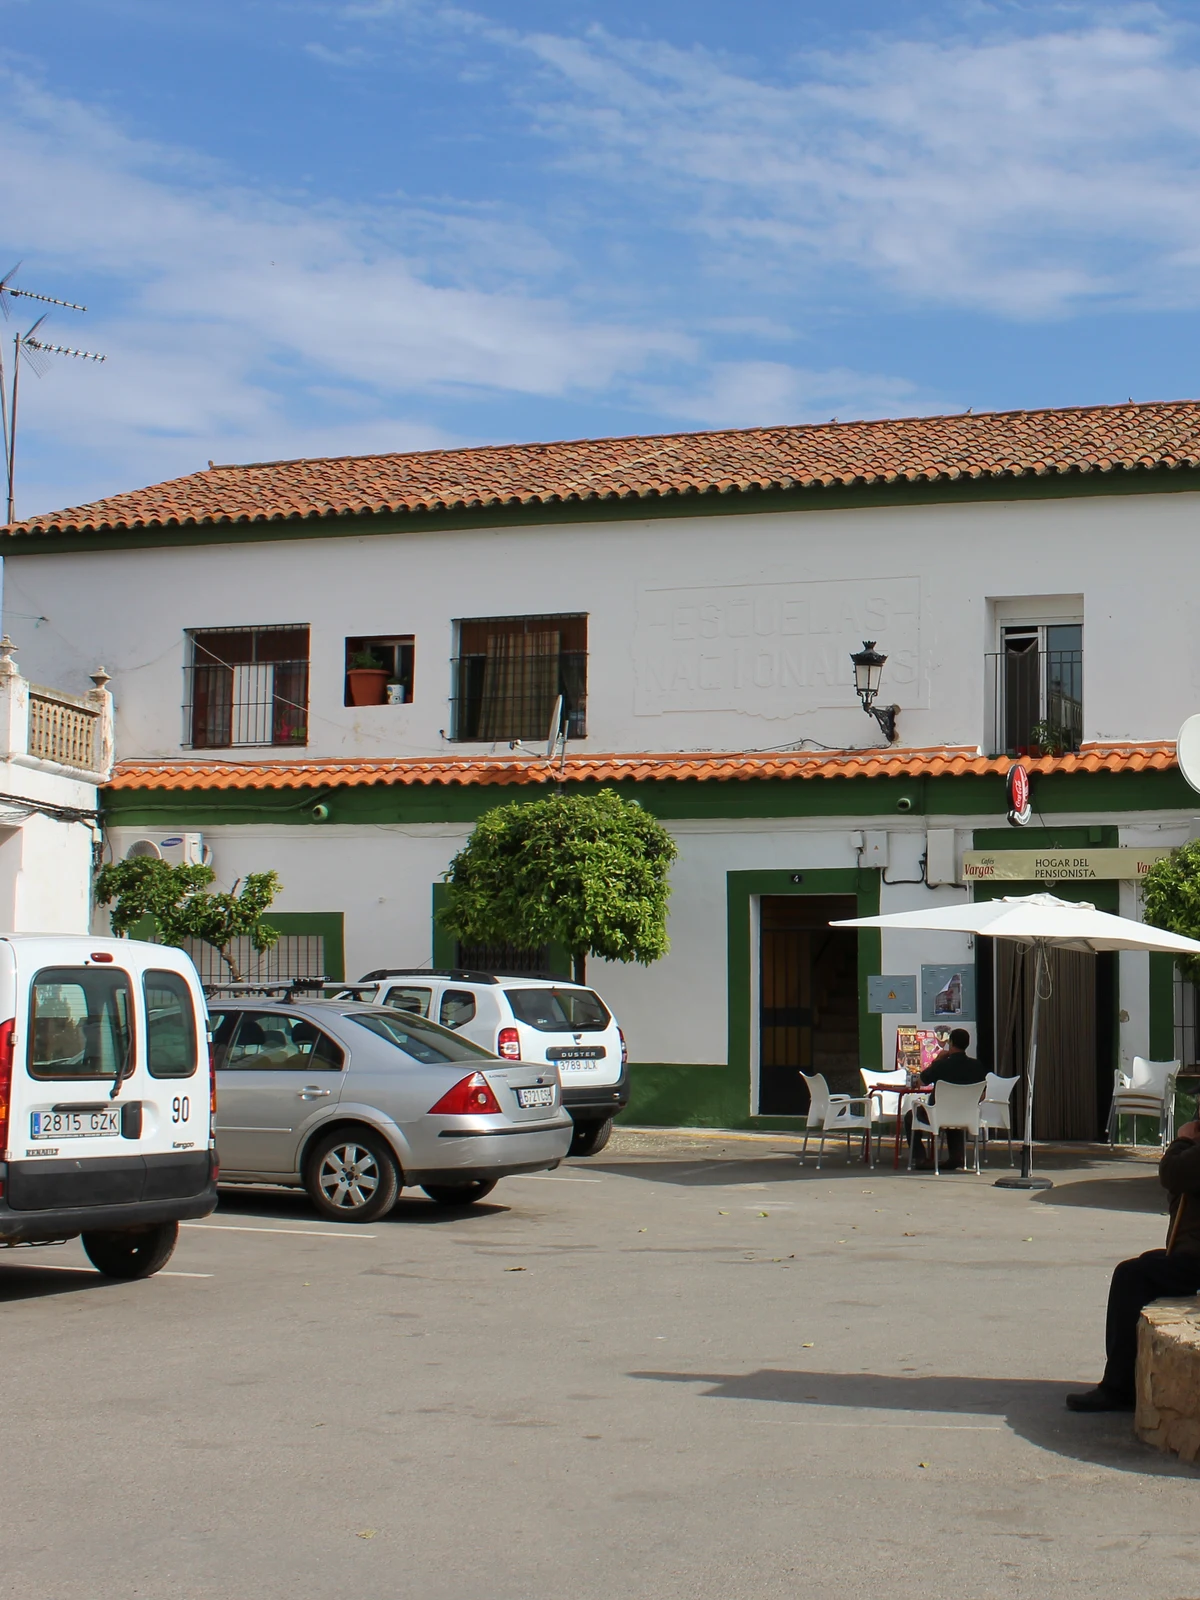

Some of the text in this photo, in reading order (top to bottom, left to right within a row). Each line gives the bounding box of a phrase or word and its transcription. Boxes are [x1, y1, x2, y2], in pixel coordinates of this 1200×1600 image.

[672, 596, 889, 641] ESCUELAS
[981, 857, 995, 865] Cafés
[1035, 858, 1089, 868] HOGAR DEL
[965, 864, 995, 878] Vargas
[1035, 869, 1096, 878] PENSIONISTA
[560, 1060, 598, 1071] 3789 JLX
[523, 1089, 539, 1103] 6721
[172, 1096, 190, 1124] 90
[43, 1113, 118, 1132] 2815 GZK
